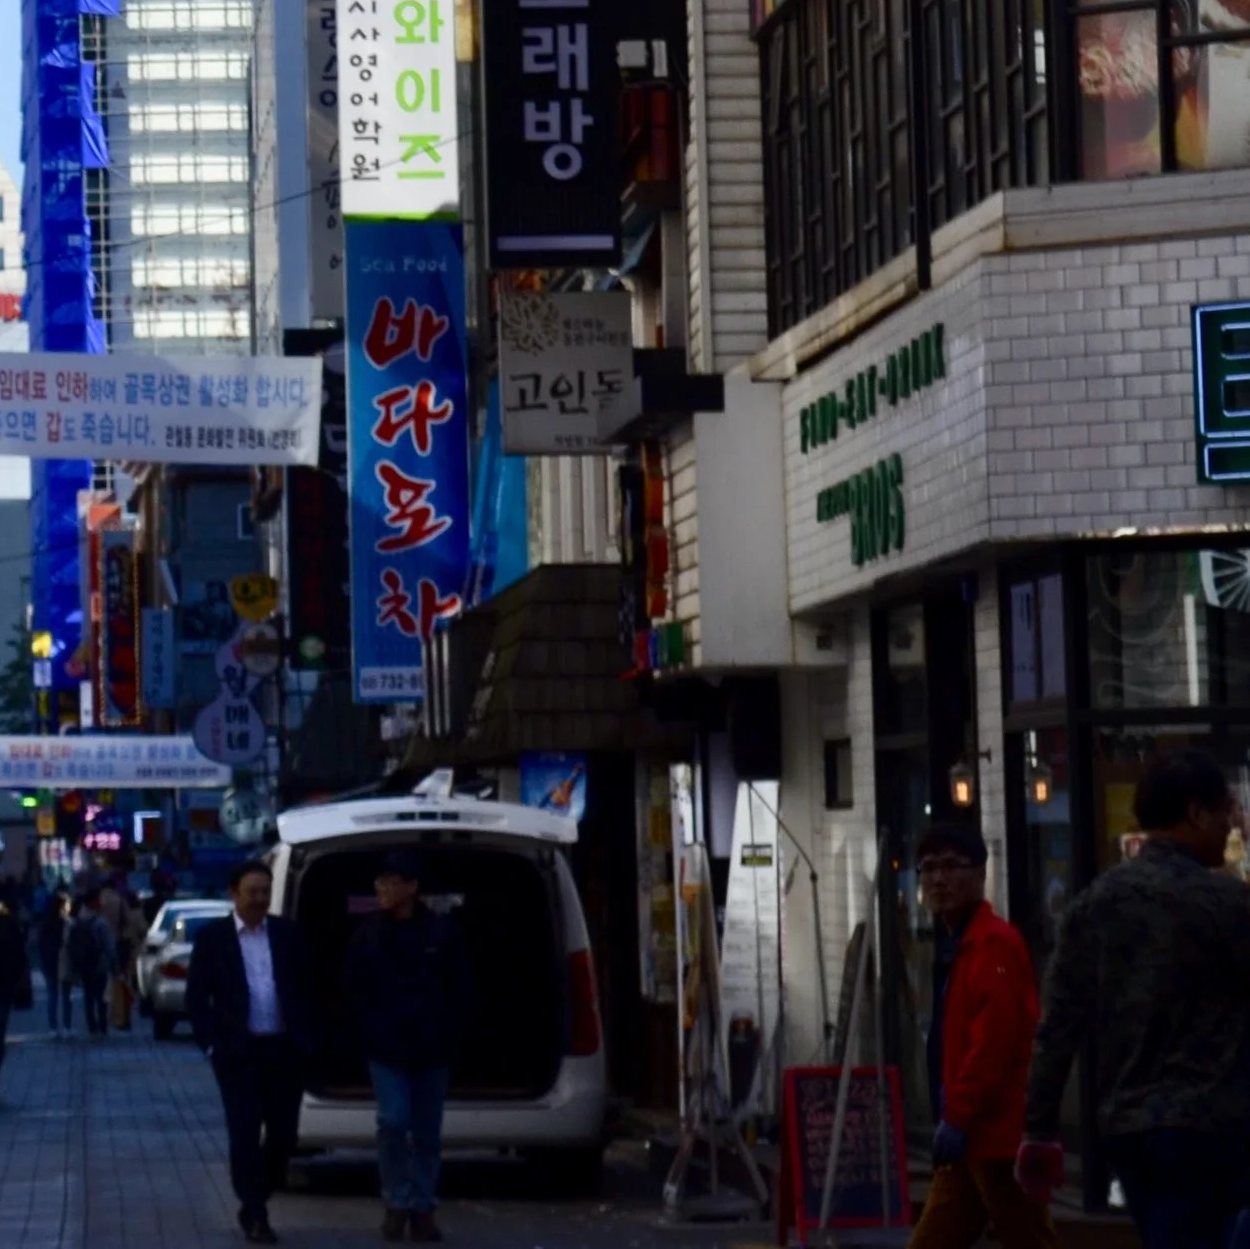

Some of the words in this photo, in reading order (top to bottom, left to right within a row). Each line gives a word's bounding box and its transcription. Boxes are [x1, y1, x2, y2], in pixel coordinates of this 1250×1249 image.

[348, 0, 382, 182] 시사영어학원
[45, 410, 77, 443] 갑도
[81, 412, 157, 446] 죽습니다.
[124, 373, 191, 406] 골목상권
[365, 297, 462, 641] 바다포차
